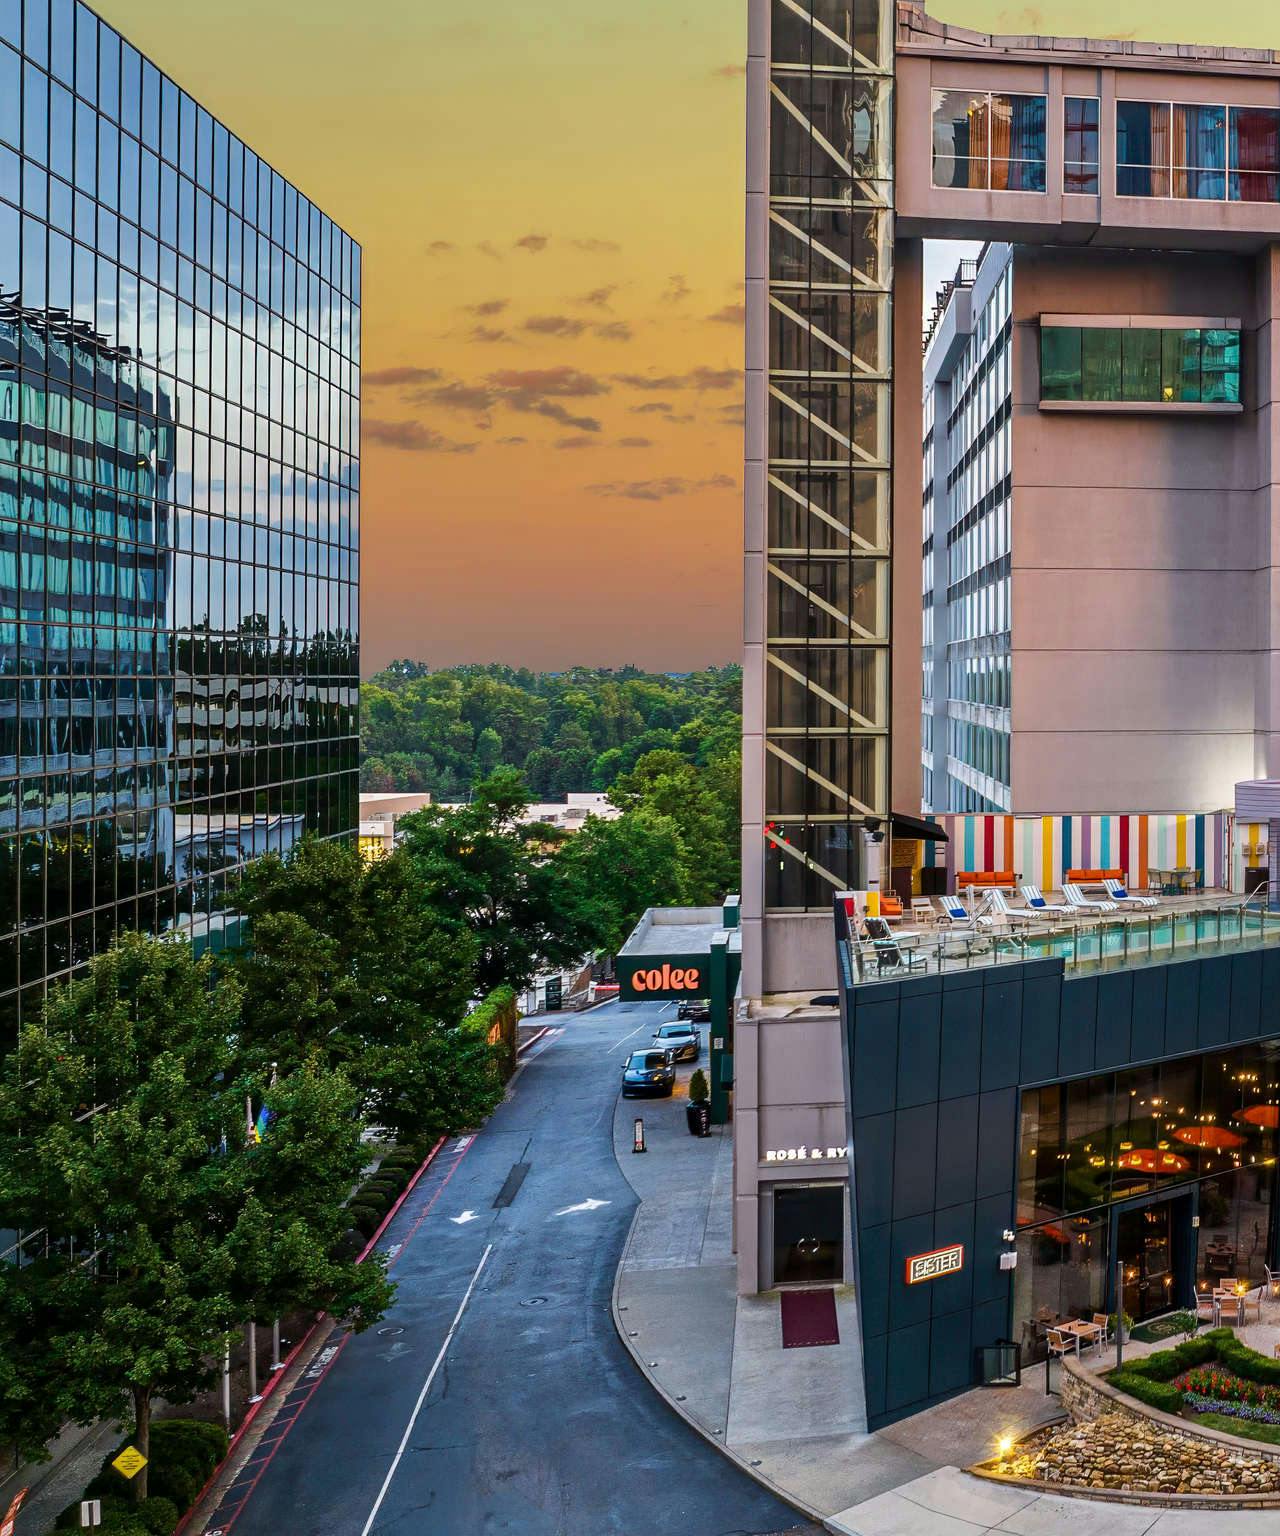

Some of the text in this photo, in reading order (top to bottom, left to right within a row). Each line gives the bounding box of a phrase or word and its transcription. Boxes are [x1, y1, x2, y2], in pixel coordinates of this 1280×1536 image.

[632, 964, 700, 992] colee
[766, 1145, 807, 1161] ROSÉ
[811, 1148, 823, 1159] &
[915, 1251, 958, 1277] SISTER
